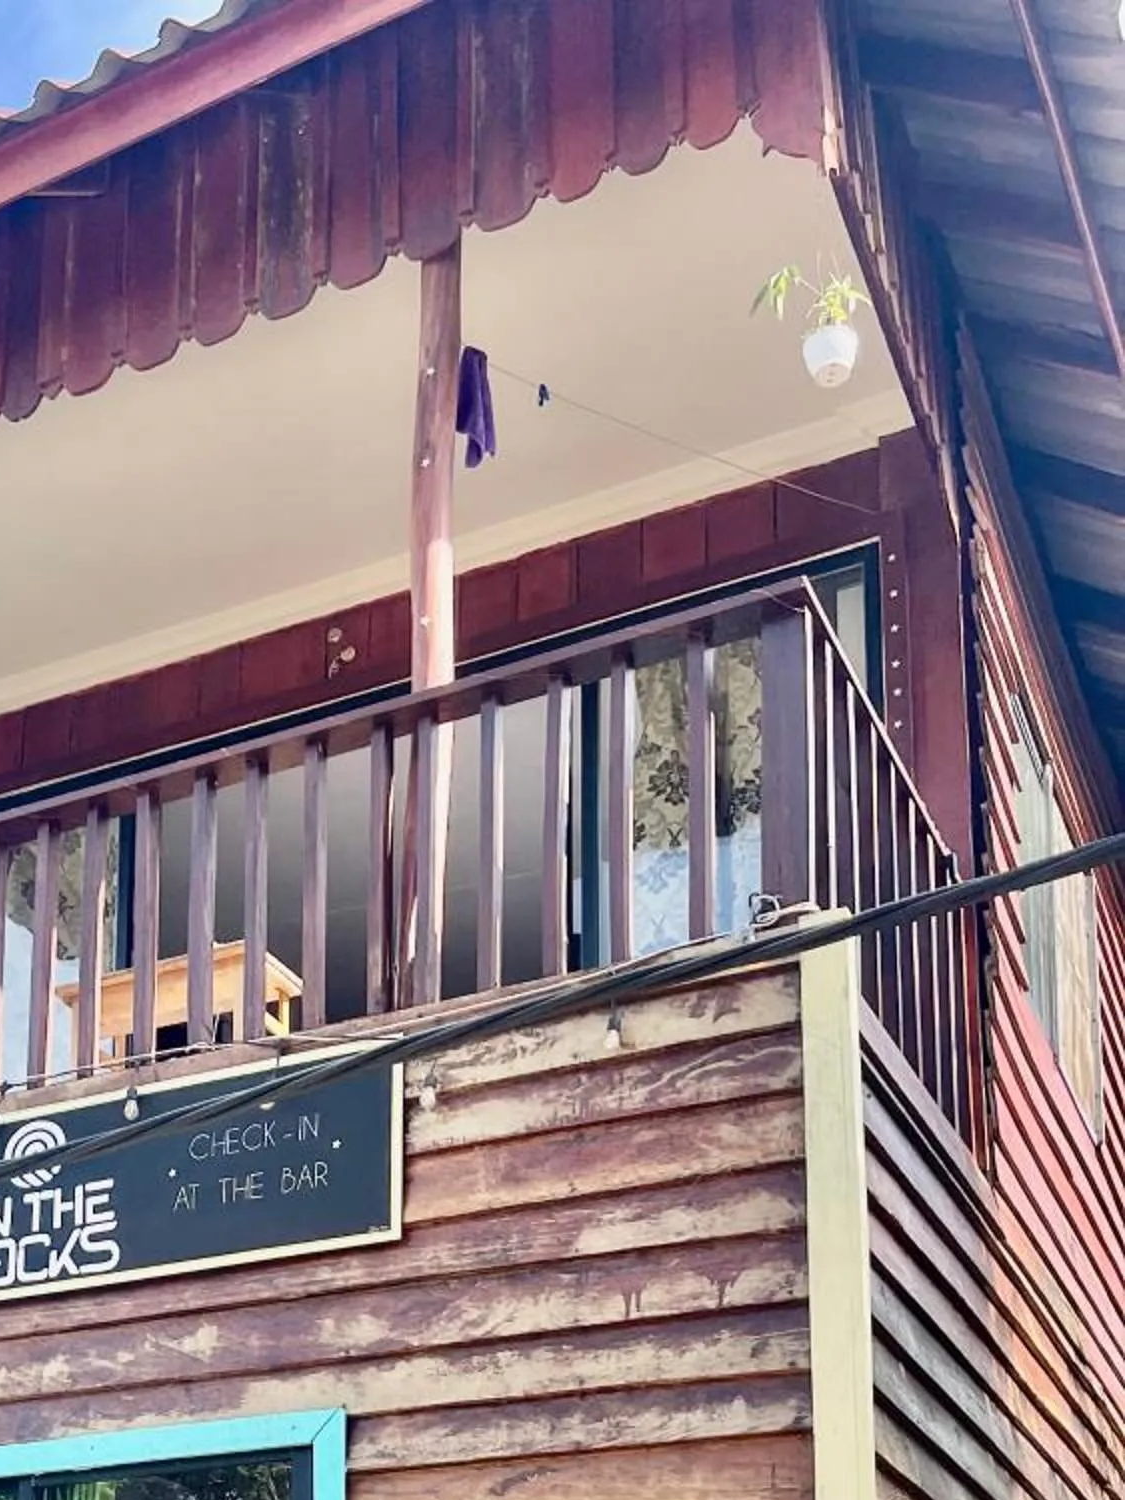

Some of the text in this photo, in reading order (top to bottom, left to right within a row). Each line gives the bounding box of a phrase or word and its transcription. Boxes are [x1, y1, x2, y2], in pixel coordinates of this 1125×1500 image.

[188, 1112, 321, 1161] CHECK-IN
[23, 1177, 114, 1232] THE
[173, 1161, 328, 1211] AT THE BAR
